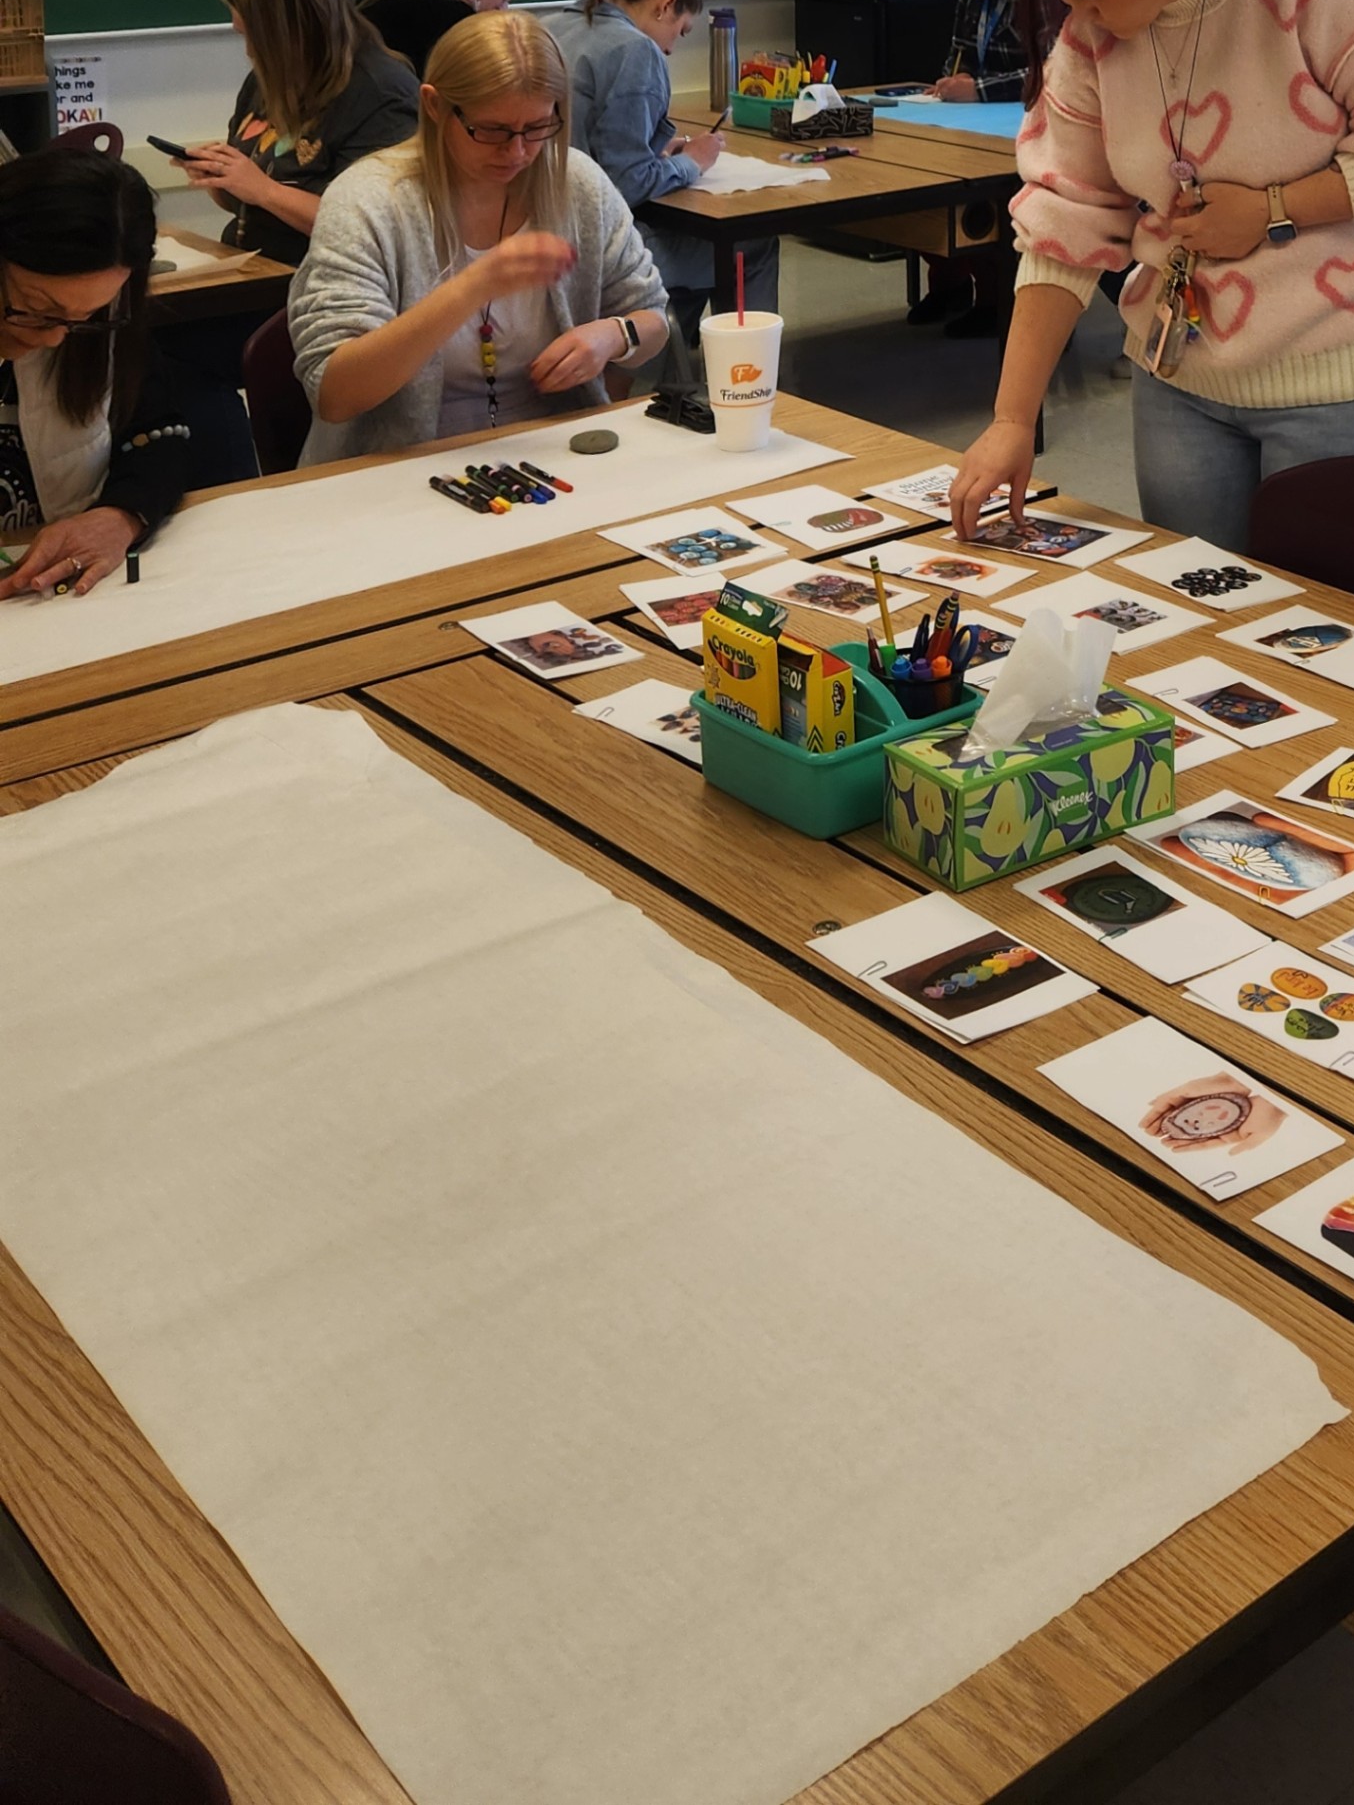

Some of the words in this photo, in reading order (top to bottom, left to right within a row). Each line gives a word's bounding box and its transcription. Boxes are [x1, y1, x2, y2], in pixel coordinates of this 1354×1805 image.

[54, 66, 86, 78] hings
[55, 80, 71, 90] ke
[75, 80, 95, 90] me
[70, 92, 93, 103] and
[56, 107, 103, 124] OKAY!
[719, 592, 730, 606] 10
[711, 634, 755, 666] Crayola
[789, 670, 803, 692] 10
[1050, 791, 1094, 816] Kleenex
